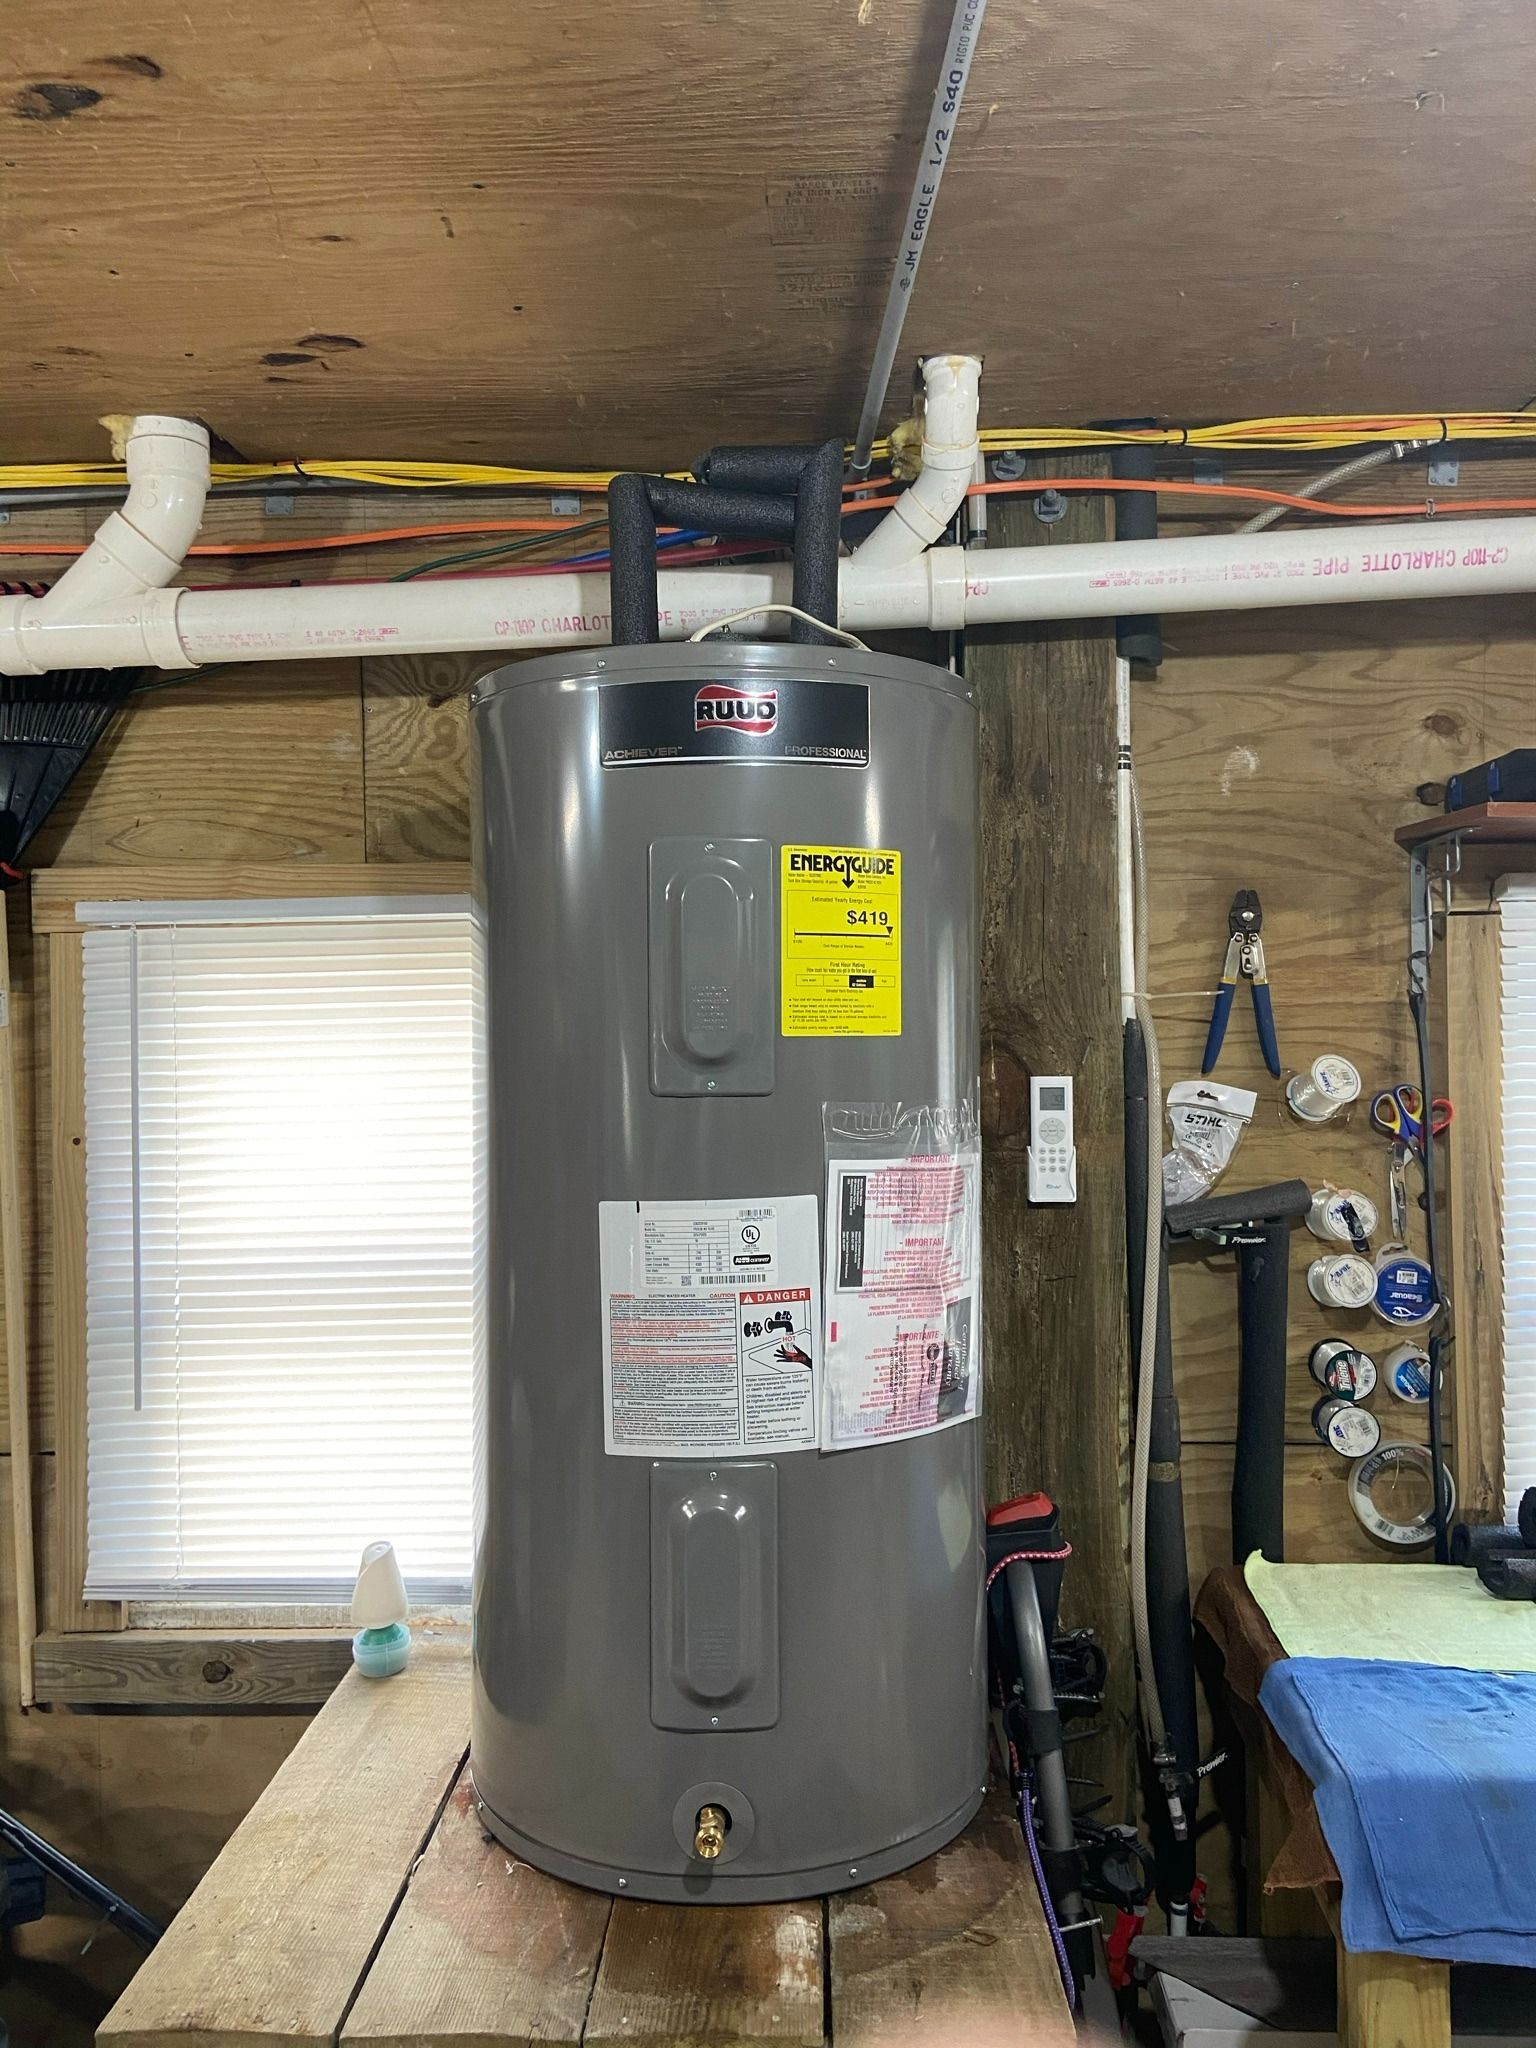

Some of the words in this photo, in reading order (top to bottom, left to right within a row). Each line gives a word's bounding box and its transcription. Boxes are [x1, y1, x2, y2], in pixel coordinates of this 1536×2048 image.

[963, 13, 976, 32] PVC
[942, 70, 963, 113] S40
[930, 129, 950, 166] 1/2
[911, 184, 935, 241] EAGLE
[905, 250, 918, 271] JM
[1312, 556, 1350, 576] PIPE
[1361, 550, 1457, 573] CHARLOTTE
[696, 700, 776, 721] RUUD
[847, 909, 888, 926] $419
[1184, 1113, 1224, 1128] STIHL
[746, 1229, 756, 1240] UL
[758, 1290, 806, 1302] DANGER
[1336, 1360, 1352, 1392] Trilene
[1382, 1448, 1404, 1461] 100%
